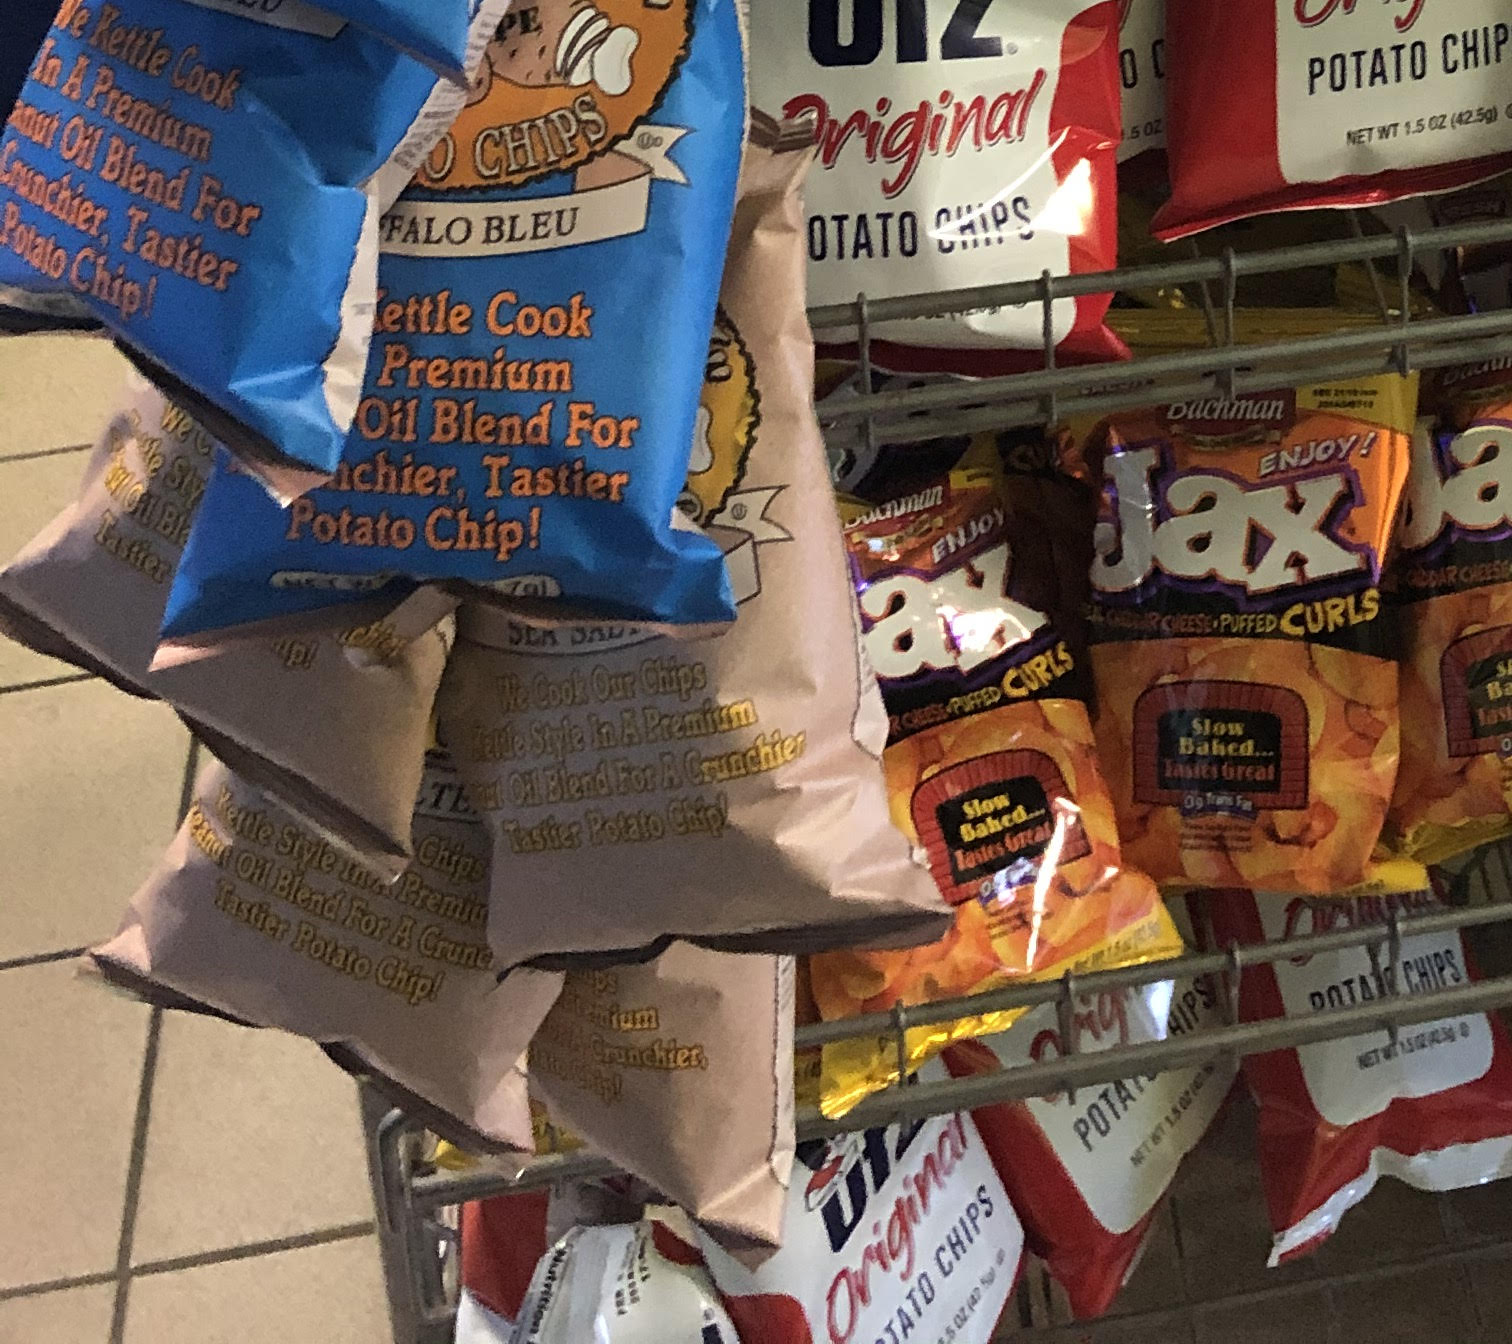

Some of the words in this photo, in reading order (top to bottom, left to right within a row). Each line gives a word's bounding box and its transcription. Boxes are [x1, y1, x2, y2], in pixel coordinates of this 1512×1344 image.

[89, 4, 170, 80] Kettle
[171, 34, 243, 111] Cook
[1308, 41, 1427, 95] POTATO
[473, 92, 609, 178] CHIPS
[59, 119, 101, 170] Oil
[102, 136, 189, 210] Blend
[198, 180, 263, 237] For
[482, 207, 580, 244] BLEU
[486, 293, 594, 339] Cook
[377, 345, 573, 393] Premium
[358, 396, 418, 440] Oil
[434, 397, 550, 446] Blend
[564, 403, 640, 449] For
[482, 453, 629, 503] Tastier
[1258, 433, 1374, 477] ENJOY!
[286, 500, 414, 550] Potato
[425, 508, 542, 561] Chip!
[1092, 448, 1373, 593] Jax
[1279, 588, 1381, 636] CURLS
[1191, 718, 1246, 739] Slow
[588, 805, 664, 846] Potato
[668, 792, 730, 838] Chip!
[963, 793, 1011, 817] Slow
[293, 920, 371, 982] Potato
[375, 956, 446, 1006] Chip!
[1404, 949, 1464, 995] CHIPS
[826, 1114, 974, 1337] Original
[934, 1183, 996, 1279] CHIPS
